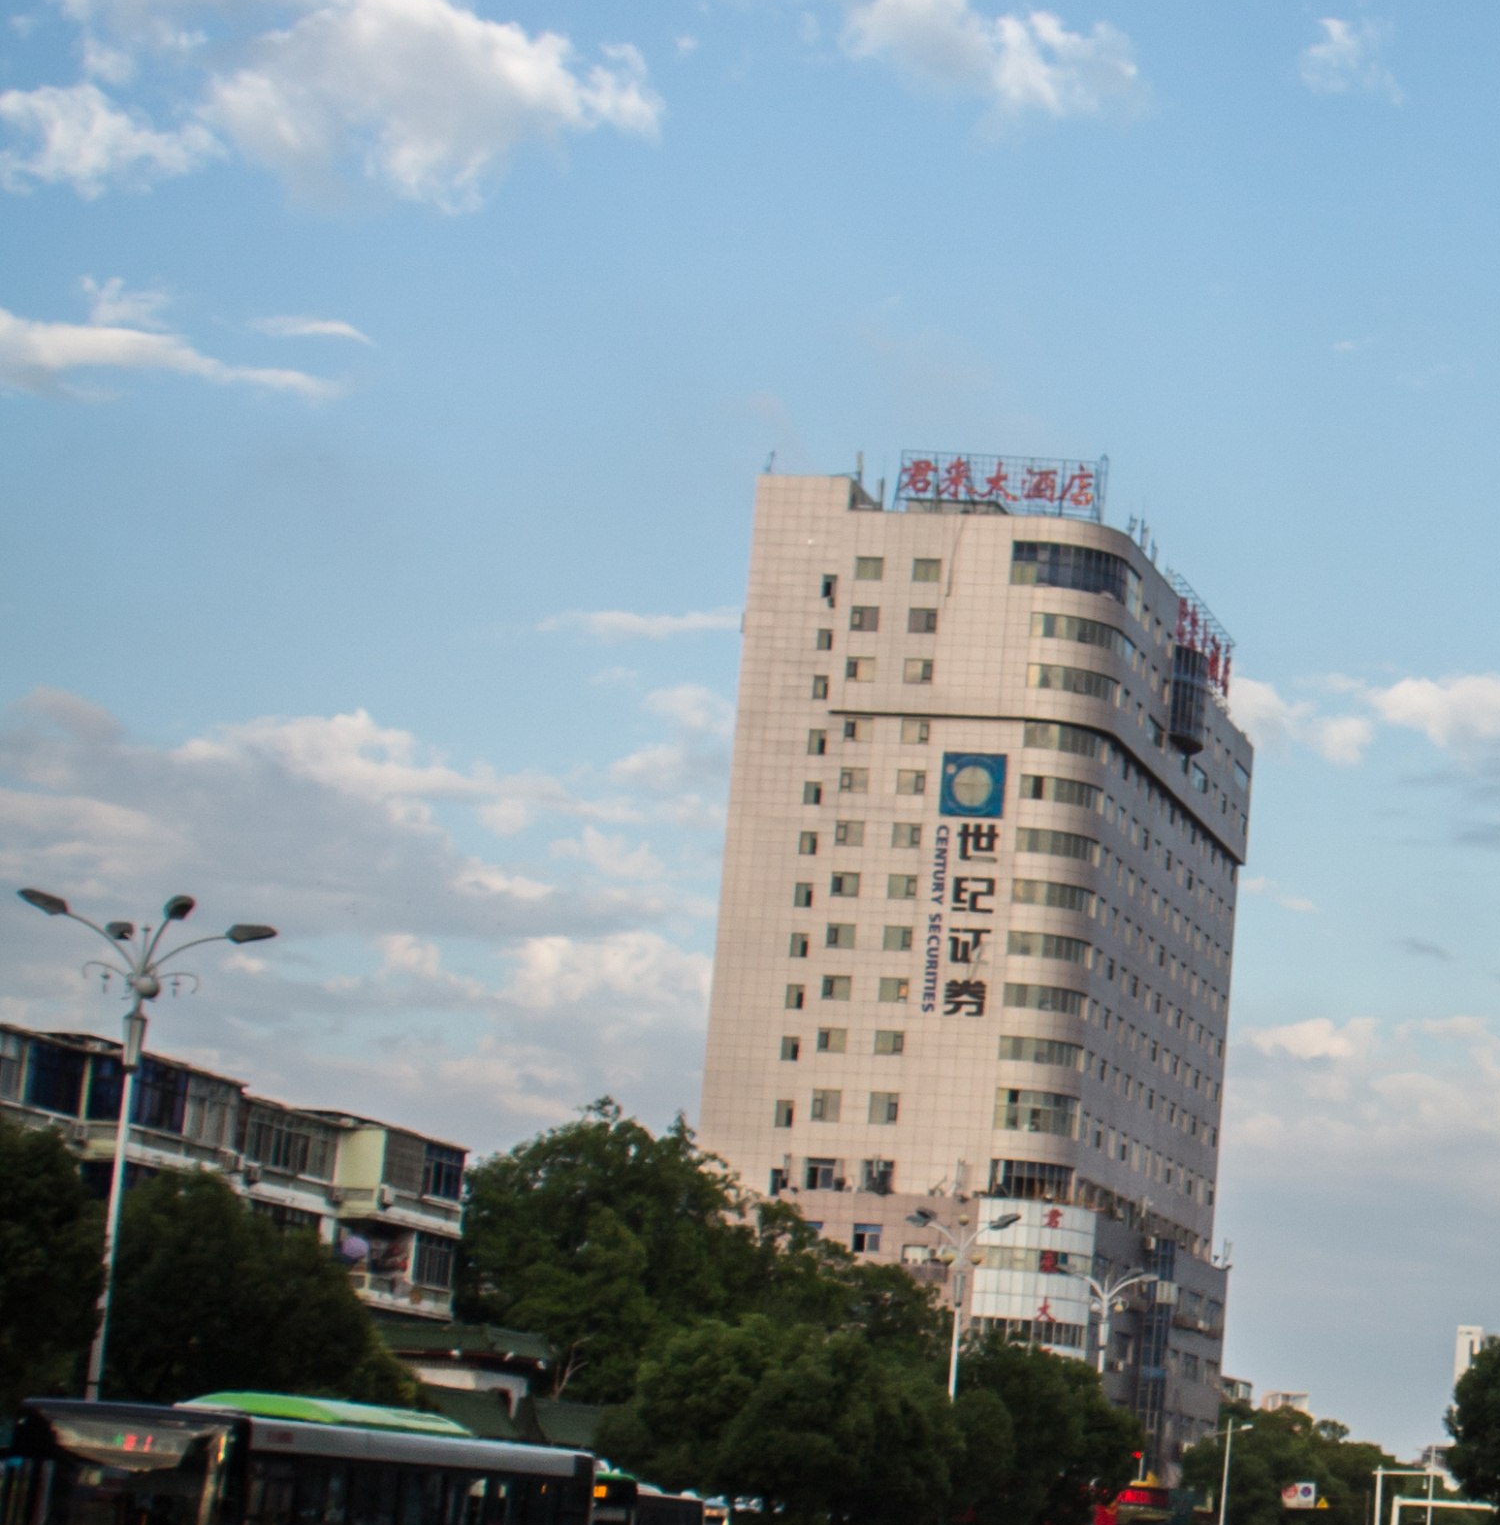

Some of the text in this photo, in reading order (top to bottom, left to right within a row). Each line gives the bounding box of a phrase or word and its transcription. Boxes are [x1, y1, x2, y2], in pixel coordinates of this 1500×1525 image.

[920, 824, 949, 1014] CENTURY SECURITIES
[942, 823, 999, 1017] 世纪证券
[1034, 1208, 1063, 1355] 君来大
